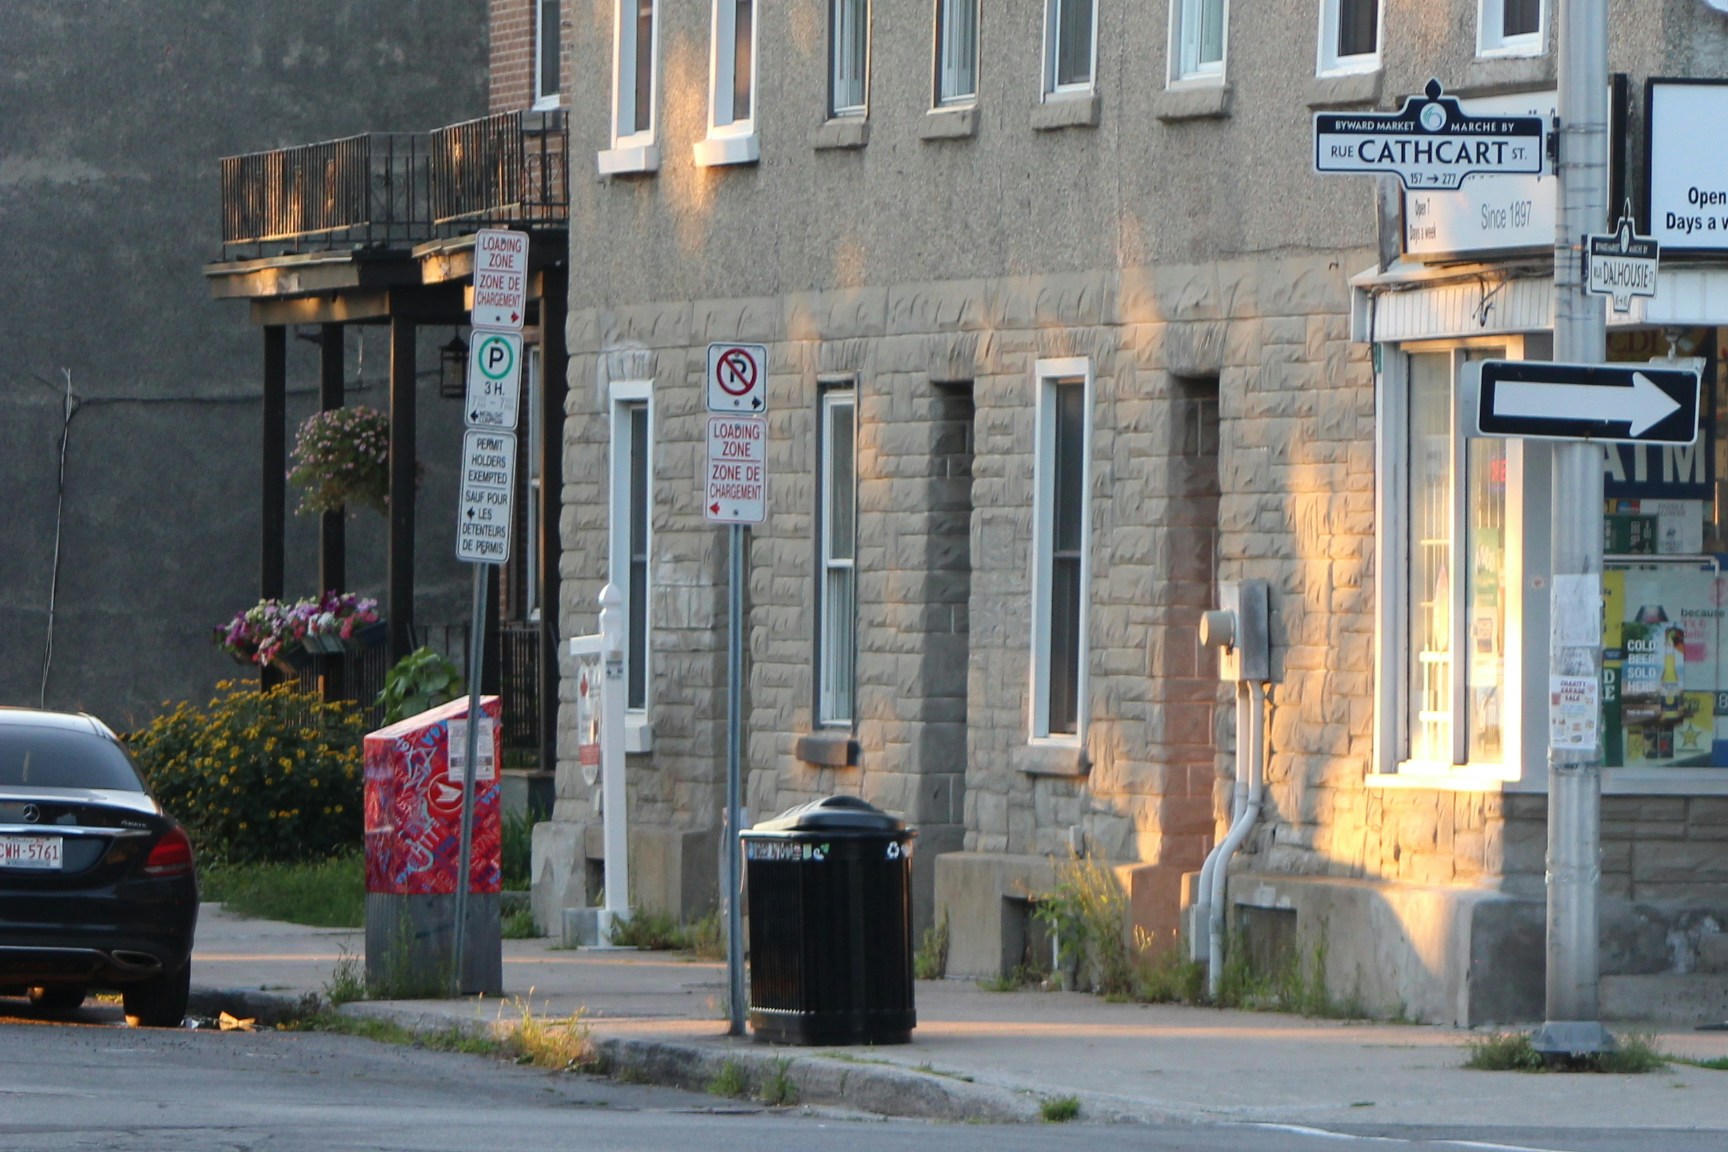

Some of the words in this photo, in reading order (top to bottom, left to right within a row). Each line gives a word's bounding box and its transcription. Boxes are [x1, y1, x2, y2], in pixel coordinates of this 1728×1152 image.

[1335, 120, 1375, 131] BYWARD
[1376, 121, 1416, 132] MARKET
[1501, 122, 1515, 133] BY
[1330, 145, 1354, 158] RUE
[1357, 139, 1509, 165] CATHCART
[1511, 148, 1528, 161] ST.
[1410, 173, 1424, 184] 157
[1442, 173, 1457, 185] 277
[1688, 186, 1727, 209] Open
[1481, 203, 1507, 230] Since
[1509, 200, 1532, 227] 1897
[1665, 212, 1703, 235] Days
[1707, 217, 1717, 230] a
[482, 236, 522, 253] LOADING
[489, 253, 514, 268] ZONE
[1603, 261, 1649, 288] DALHOUSIE
[480, 275, 504, 289] ZONE
[508, 277, 520, 291] DE
[477, 291, 521, 308] CHARGEMENT
[489, 346, 504, 369] P
[484, 381, 491, 395] 3
[713, 423, 760, 440] LOADING
[477, 438, 504, 452] PERMIT
[722, 441, 751, 457] ZONE
[471, 455, 506, 468] HOLDERS
[468, 470, 507, 484] EXEMPTED
[712, 464, 741, 481] ZONE
[746, 466, 760, 482] DE
[465, 490, 485, 503] SAUF
[487, 493, 507, 505] POUR
[710, 483, 762, 500] CHARGEMENT
[478, 508, 492, 520] LES
[462, 539, 473, 551] DE
[475, 540, 503, 554] PERMIS
[1627, 639, 1656, 651] COLD
[1628, 654, 1656, 665] BEER
[1627, 667, 1656, 679] SOLD
[1627, 681, 1656, 693] HERE
